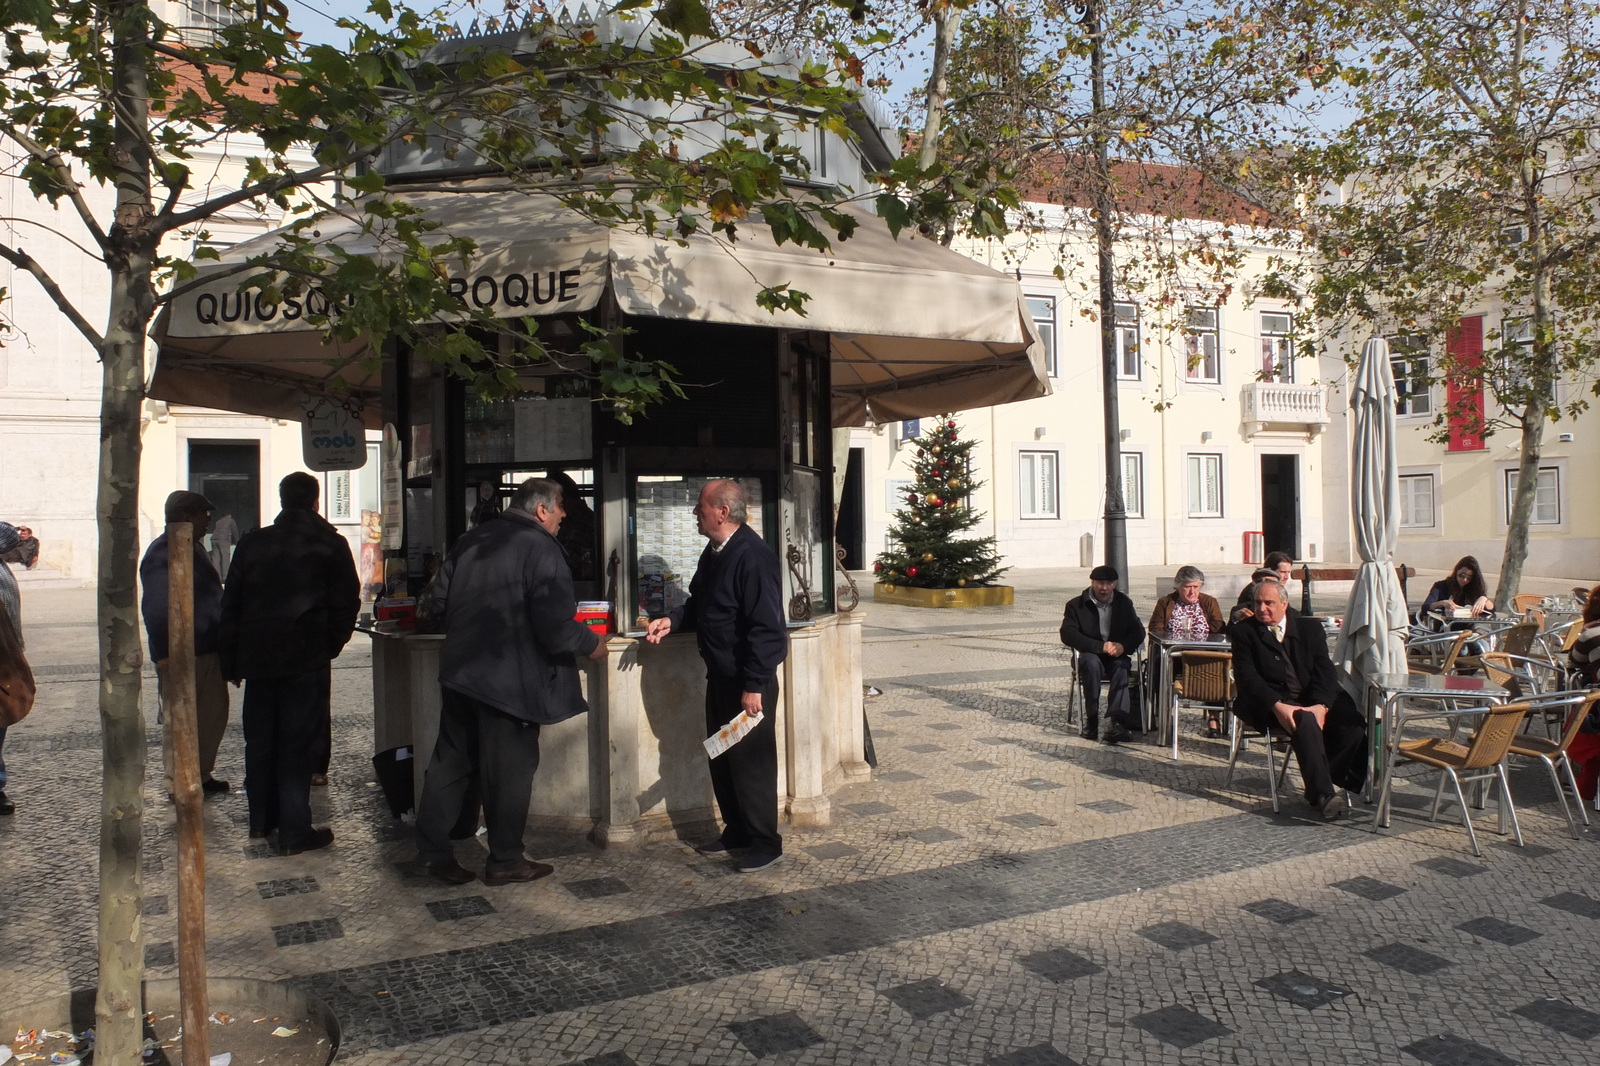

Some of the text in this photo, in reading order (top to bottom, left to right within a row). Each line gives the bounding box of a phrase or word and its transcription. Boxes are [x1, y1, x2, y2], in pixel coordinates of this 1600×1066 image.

[196, 269, 581, 325] QUIOSQ ROQUE
[312, 430, 356, 448] mob
